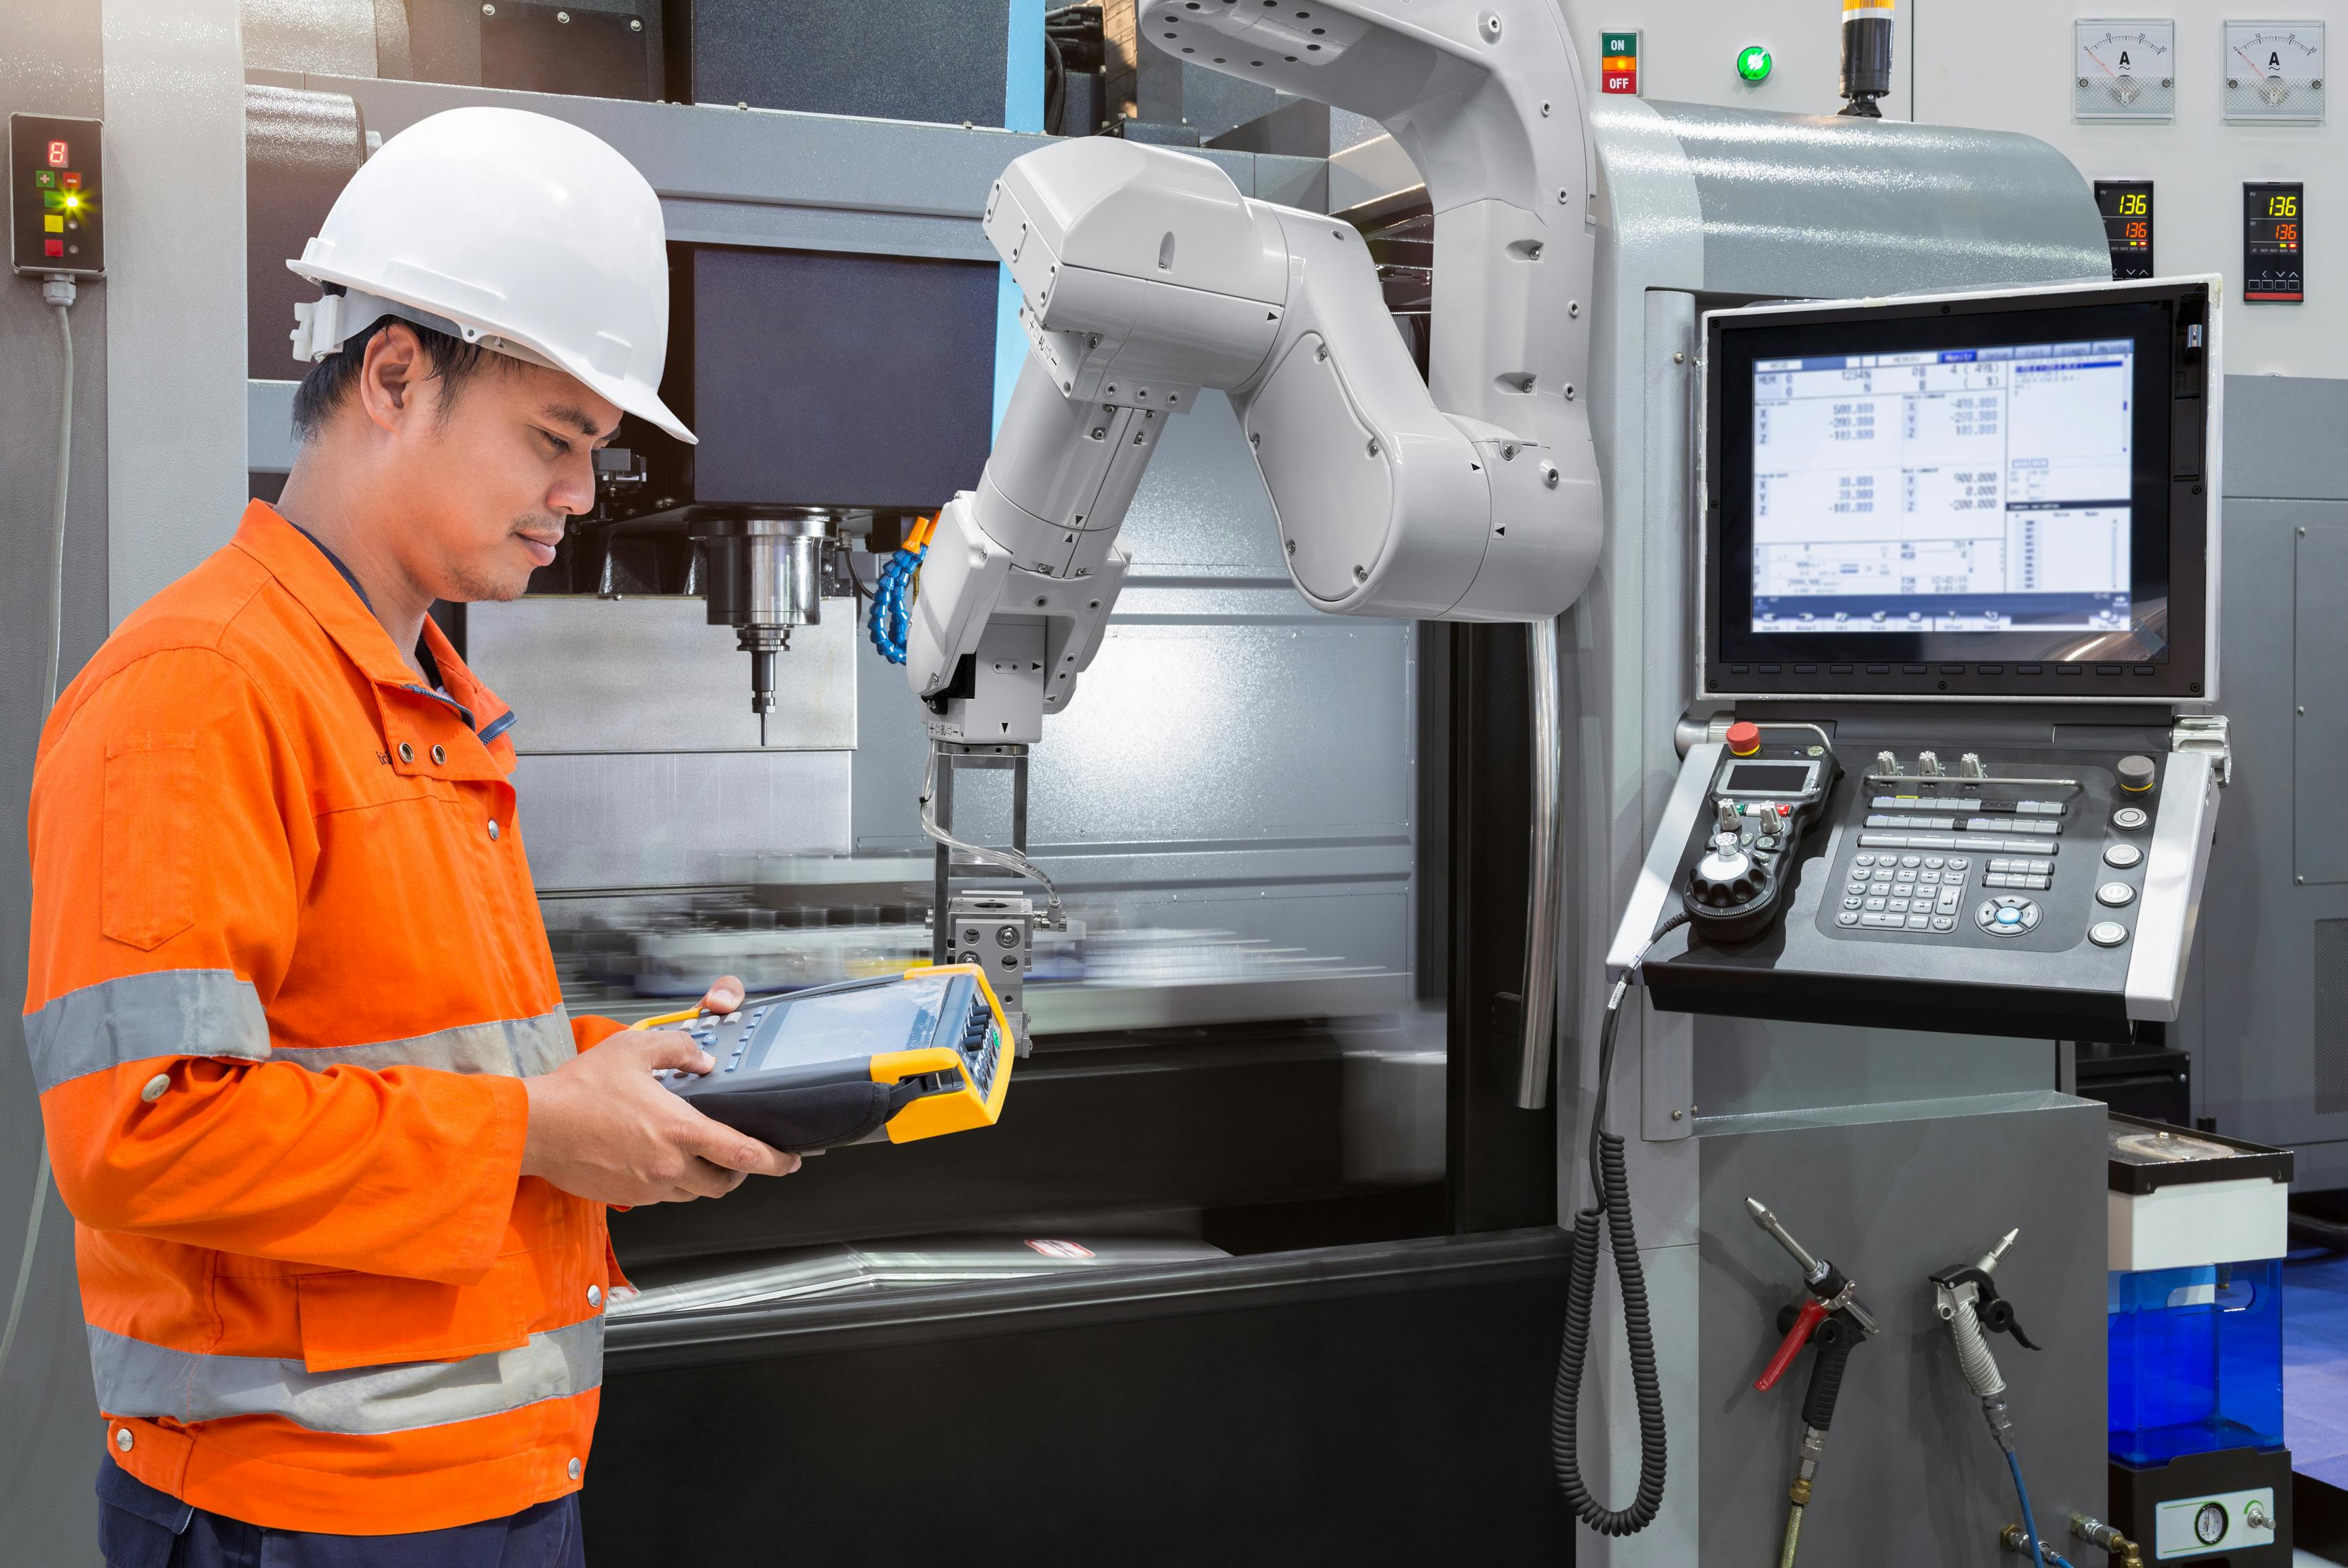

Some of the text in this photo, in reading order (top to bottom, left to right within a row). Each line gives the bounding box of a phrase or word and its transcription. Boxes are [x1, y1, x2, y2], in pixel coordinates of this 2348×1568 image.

[1610, 39, 1625, 51] ON
[2159, 45, 2167, 53] 30
[2119, 51, 2131, 65] A
[2269, 52, 2280, 66] A
[1609, 77, 1629, 90] OFF
[50, 142, 65, 164] 8
[2119, 194, 2146, 214] 136
[2269, 196, 2296, 216] 136
[2125, 222, 2146, 238] 136
[2275, 224, 2297, 240] 136
[1908, 402, 1915, 411] X
[1760, 409, 1766, 418] X
[1908, 415, 1915, 424] Y
[1760, 421, 1766, 431] Y
[1908, 427, 1915, 438] Z
[1760, 434, 1767, 444] Z
[1760, 480, 1766, 489] X
[1908, 476, 1914, 484] X
[1760, 493, 1766, 502] Y
[1908, 489, 1914, 497] Y
[1760, 505, 1766, 516] Z
[1908, 501, 1914, 512] Z
